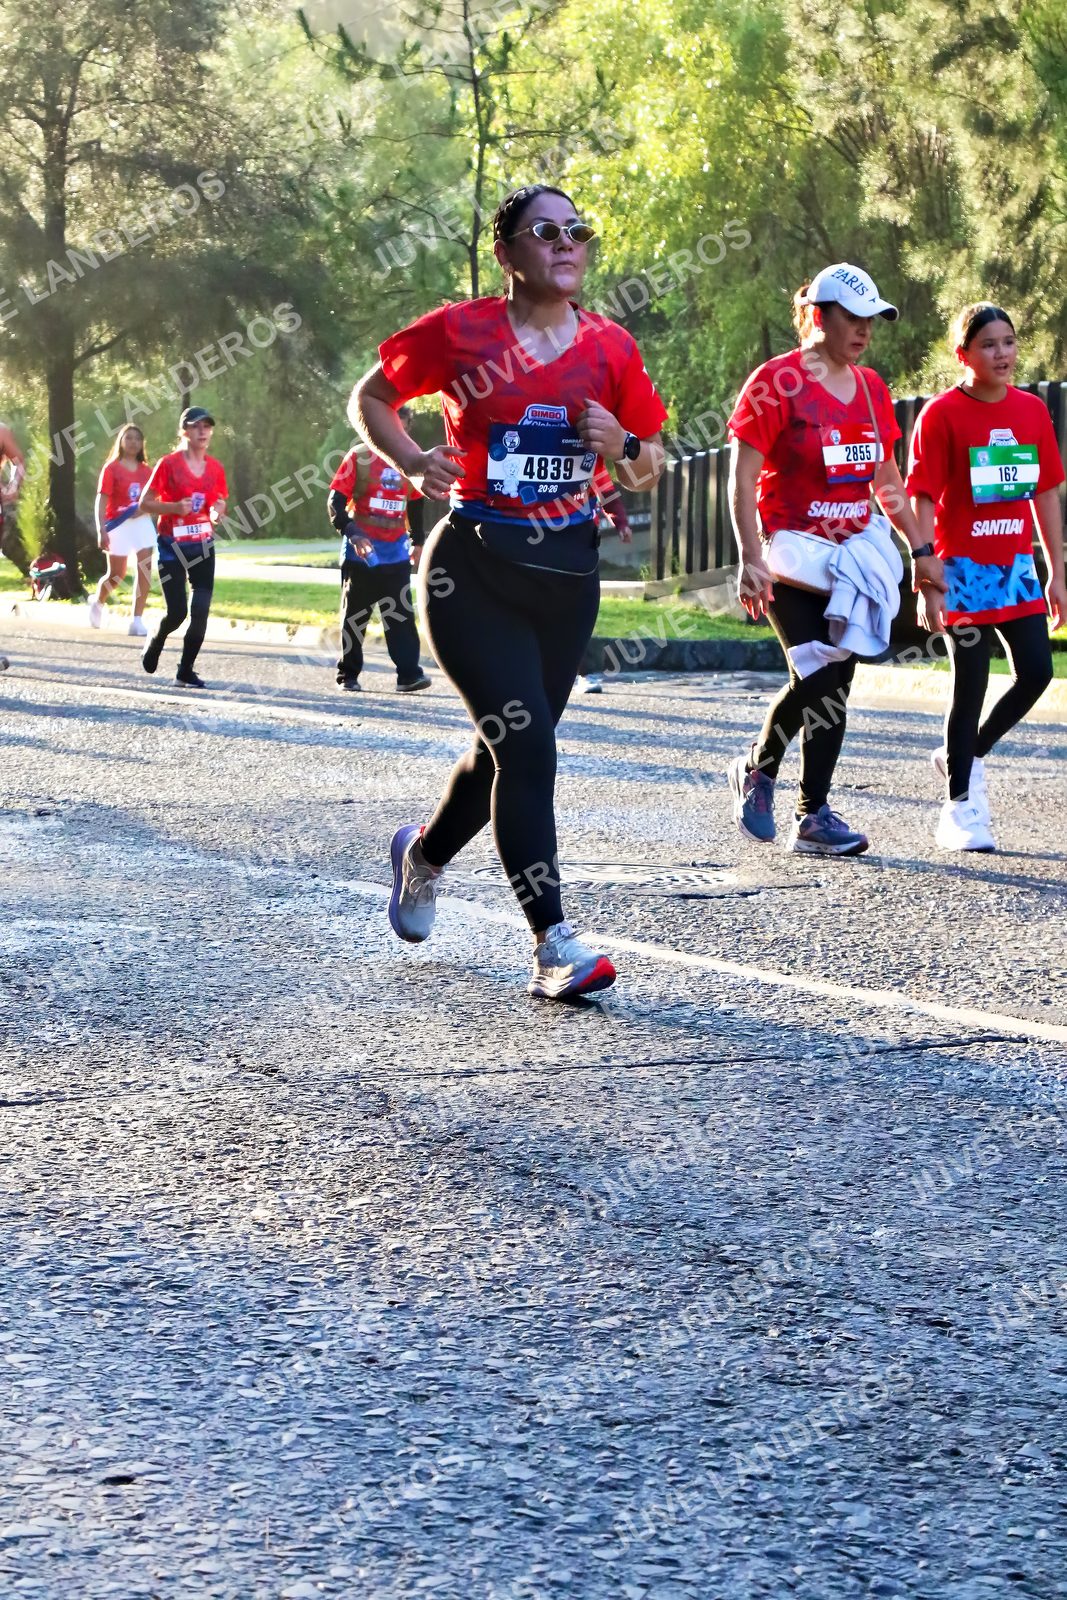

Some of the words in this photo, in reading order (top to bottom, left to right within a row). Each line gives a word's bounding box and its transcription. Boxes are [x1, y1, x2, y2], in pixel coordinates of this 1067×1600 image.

[831, 268, 869, 296] PARIS
[531, 410, 561, 420] BIMBO
[845, 444, 871, 462] 2855
[523, 457, 574, 480] 4839
[998, 466, 1018, 482] 162
